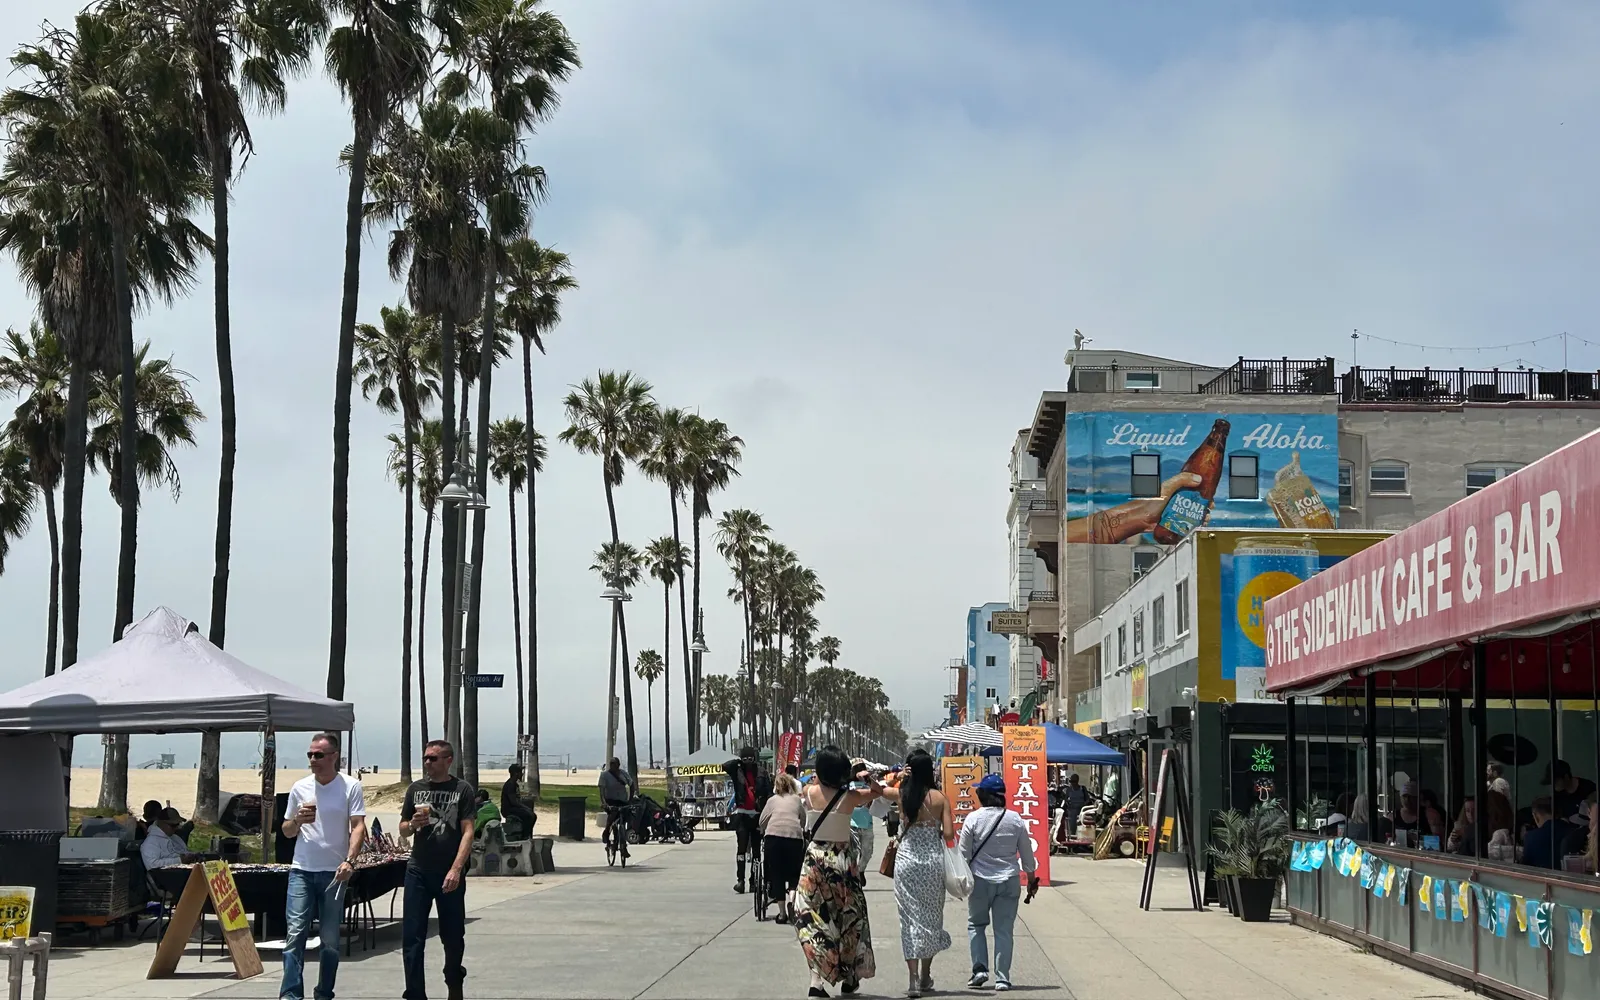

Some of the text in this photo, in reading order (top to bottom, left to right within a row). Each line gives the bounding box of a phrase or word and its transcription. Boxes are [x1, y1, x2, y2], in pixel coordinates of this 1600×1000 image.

[1106, 423, 1325, 452] Liquid Aloha
[1172, 504, 1185, 514] BIG
[1175, 494, 1205, 513] KONA
[1274, 490, 1563, 665] THE SIDEWALK CAFE & BAR
[1251, 764, 1275, 772] OPEN
[210, 867, 232, 903] FREE
